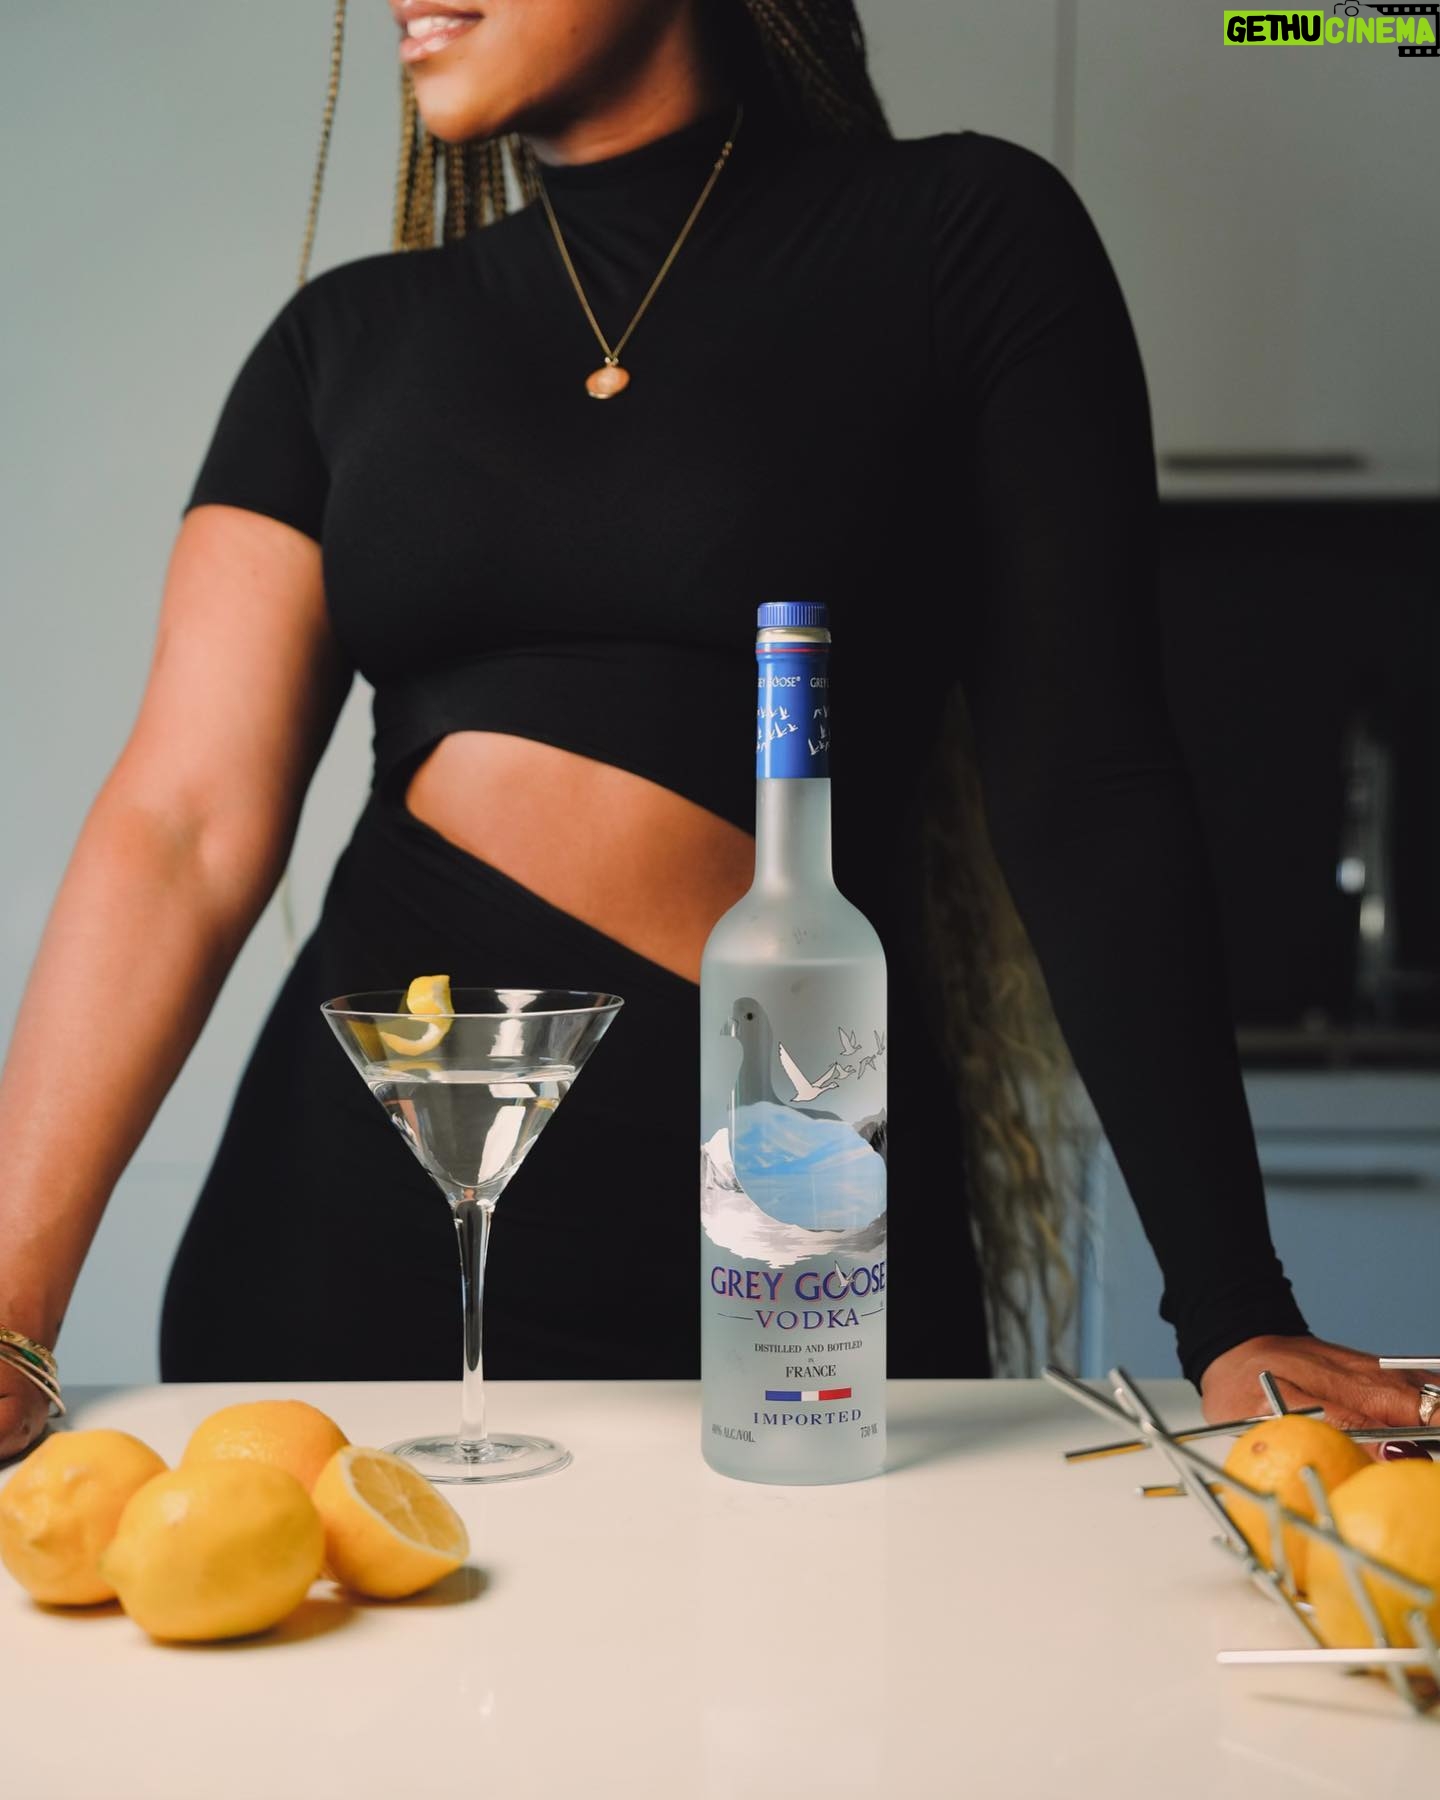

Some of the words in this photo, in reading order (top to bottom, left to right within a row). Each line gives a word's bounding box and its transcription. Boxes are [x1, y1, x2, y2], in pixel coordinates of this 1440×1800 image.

[711, 1266, 784, 1302] GREY
[794, 1261, 886, 1302] GOOSE
[755, 1308, 860, 1330] VODKA
[755, 1343, 802, 1353] DISTILLED
[805, 1342, 825, 1353] AND
[827, 1340, 863, 1352] BOTTLED
[785, 1364, 837, 1379] FRANCE
[753, 1408, 862, 1426] IMPORTED
